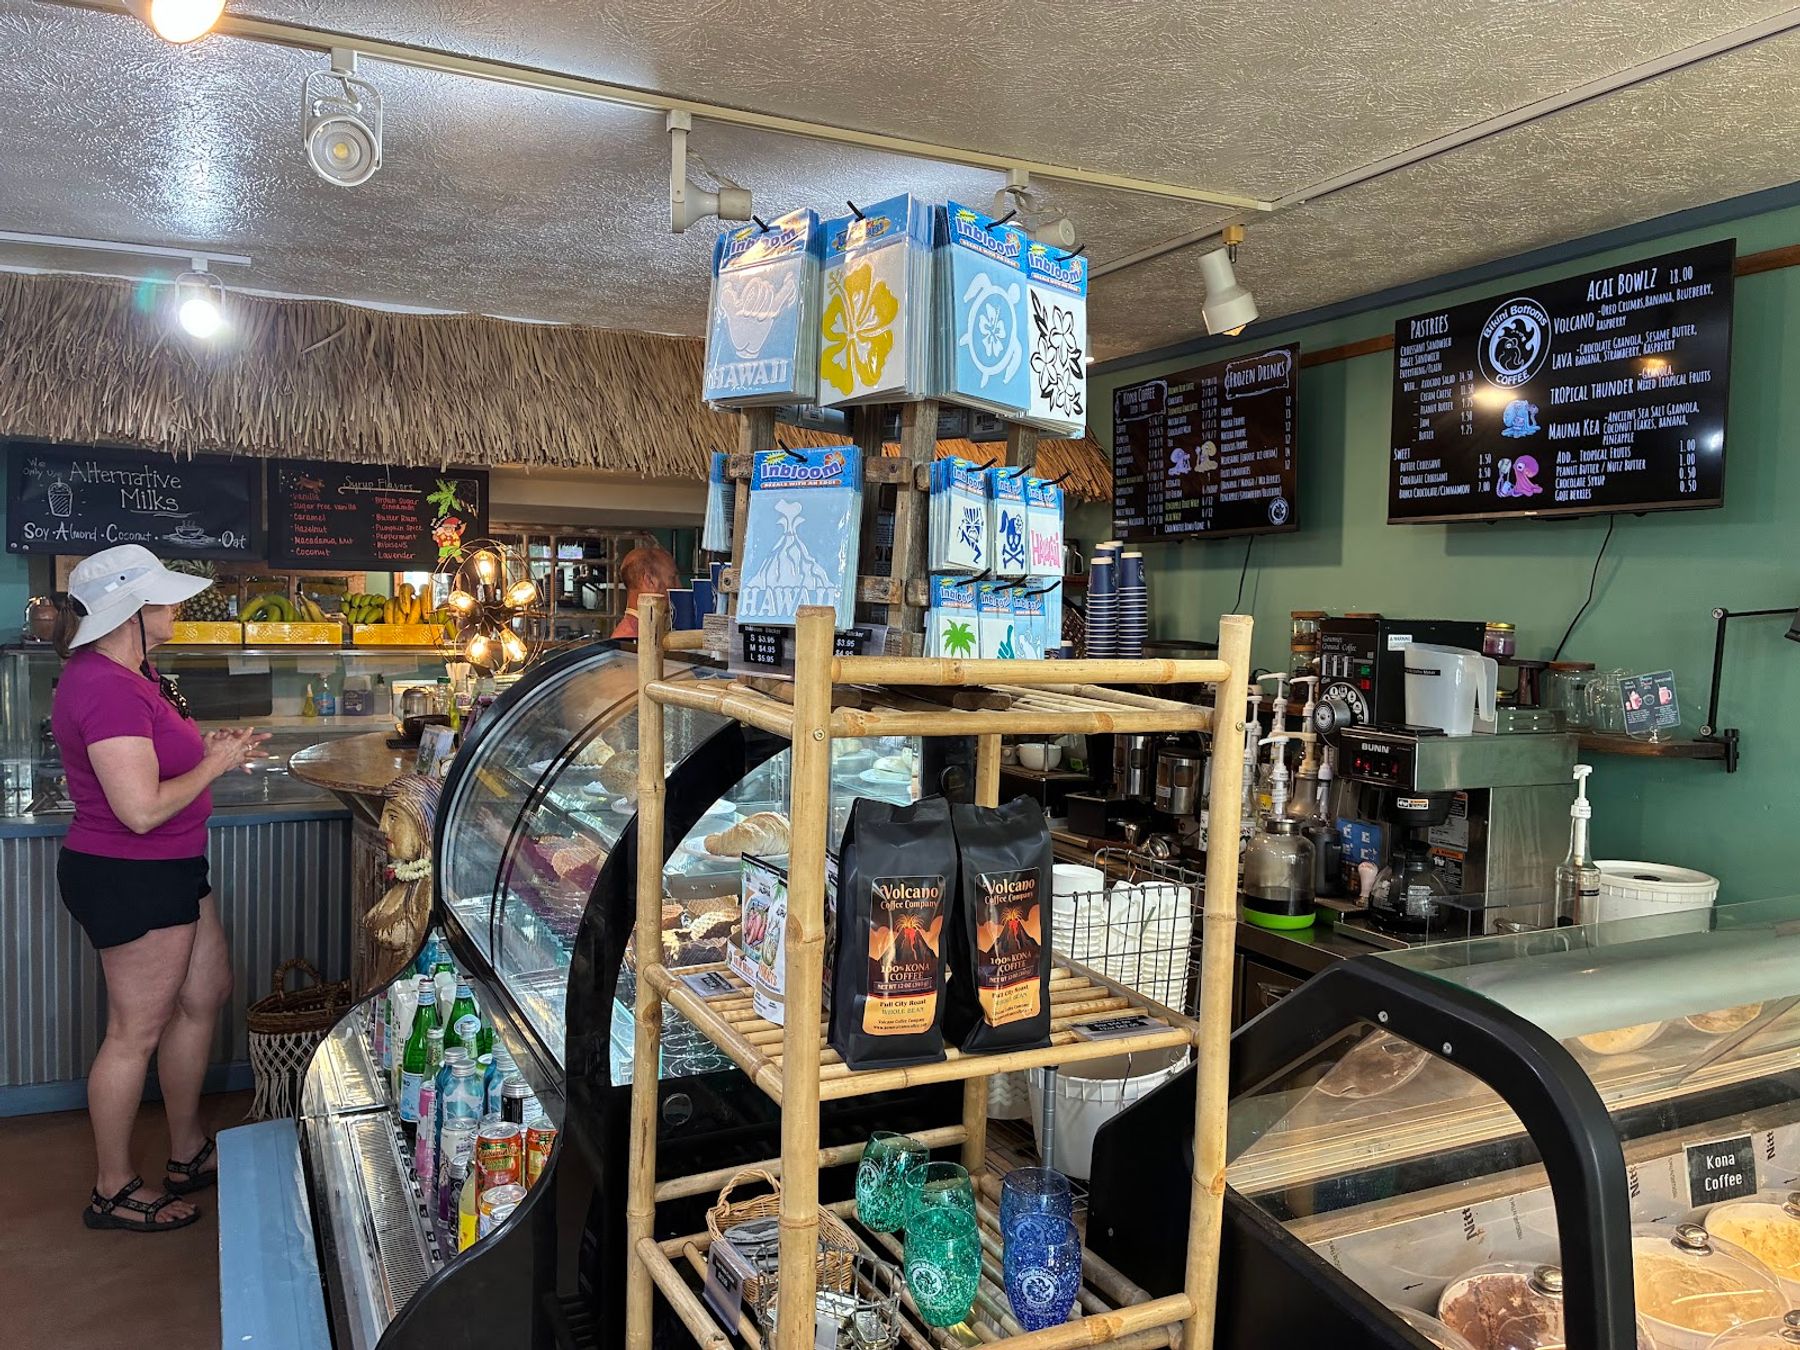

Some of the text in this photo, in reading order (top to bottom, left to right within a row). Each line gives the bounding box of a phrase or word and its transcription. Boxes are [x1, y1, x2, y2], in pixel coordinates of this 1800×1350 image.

[956, 219, 1019, 258] Inbloom
[1029, 255, 1081, 284] Inbloom
[1587, 265, 1694, 302] ACAI BOWLZ 18.00
[1410, 314, 1449, 340] PASTRIES
[1483, 305, 1548, 340] Bikini Bottoms
[1553, 312, 1595, 335] VOLCANO
[1645, 329, 1670, 343] SESAME
[1552, 352, 1573, 370] LAVA
[708, 359, 789, 390] HAWAII
[1229, 361, 1286, 389] FROZEN DRINKS
[1495, 369, 1531, 386] COFFEE
[1550, 385, 1588, 405] TROPICAL
[1592, 378, 1634, 400] THUNDER
[1658, 374, 1687, 388] TROPICAL
[1689, 370, 1711, 384] FRUITS
[1637, 407, 1650, 419] SEA
[1651, 405, 1665, 418] SALT
[1548, 418, 1600, 440] MAUNA KEA
[1603, 420, 1632, 434] COCONUT
[1602, 432, 1634, 446] PINEAPPLE
[1394, 448, 1411, 461] SWEET
[1579, 449, 1608, 462] TROPICAL
[1609, 446, 1632, 459] FRUITS
[1679, 438, 1696, 452] 1.00
[761, 463, 843, 480] Inbloom
[1555, 464, 1578, 477] PEANUT
[1624, 458, 1646, 472] BUTTER
[1679, 453, 1696, 466] 1.00
[69, 461, 181, 492] Alternative
[1555, 467, 1697, 490] CHOCOLATE SYRUP 0.50
[1569, 488, 1592, 500] BERRIES
[1679, 480, 1697, 493] 0.50
[121, 489, 179, 511] Milks
[24, 522, 246, 549] Soy Almond Coconut Oat
[295, 548, 331, 557] Coconut
[378, 551, 417, 560] Lavender
[750, 644, 756, 652] M
[1361, 742, 1390, 755] BUNN
[880, 883, 940, 902] Volcano
[985, 878, 1036, 895] Volcano
[880, 899, 940, 911] Coffee Company
[890, 972, 924, 982] COFFEE
[905, 963, 930, 972] KONA
[1706, 1153, 1736, 1170] Kona
[1705, 1173, 1743, 1192] Coffee
